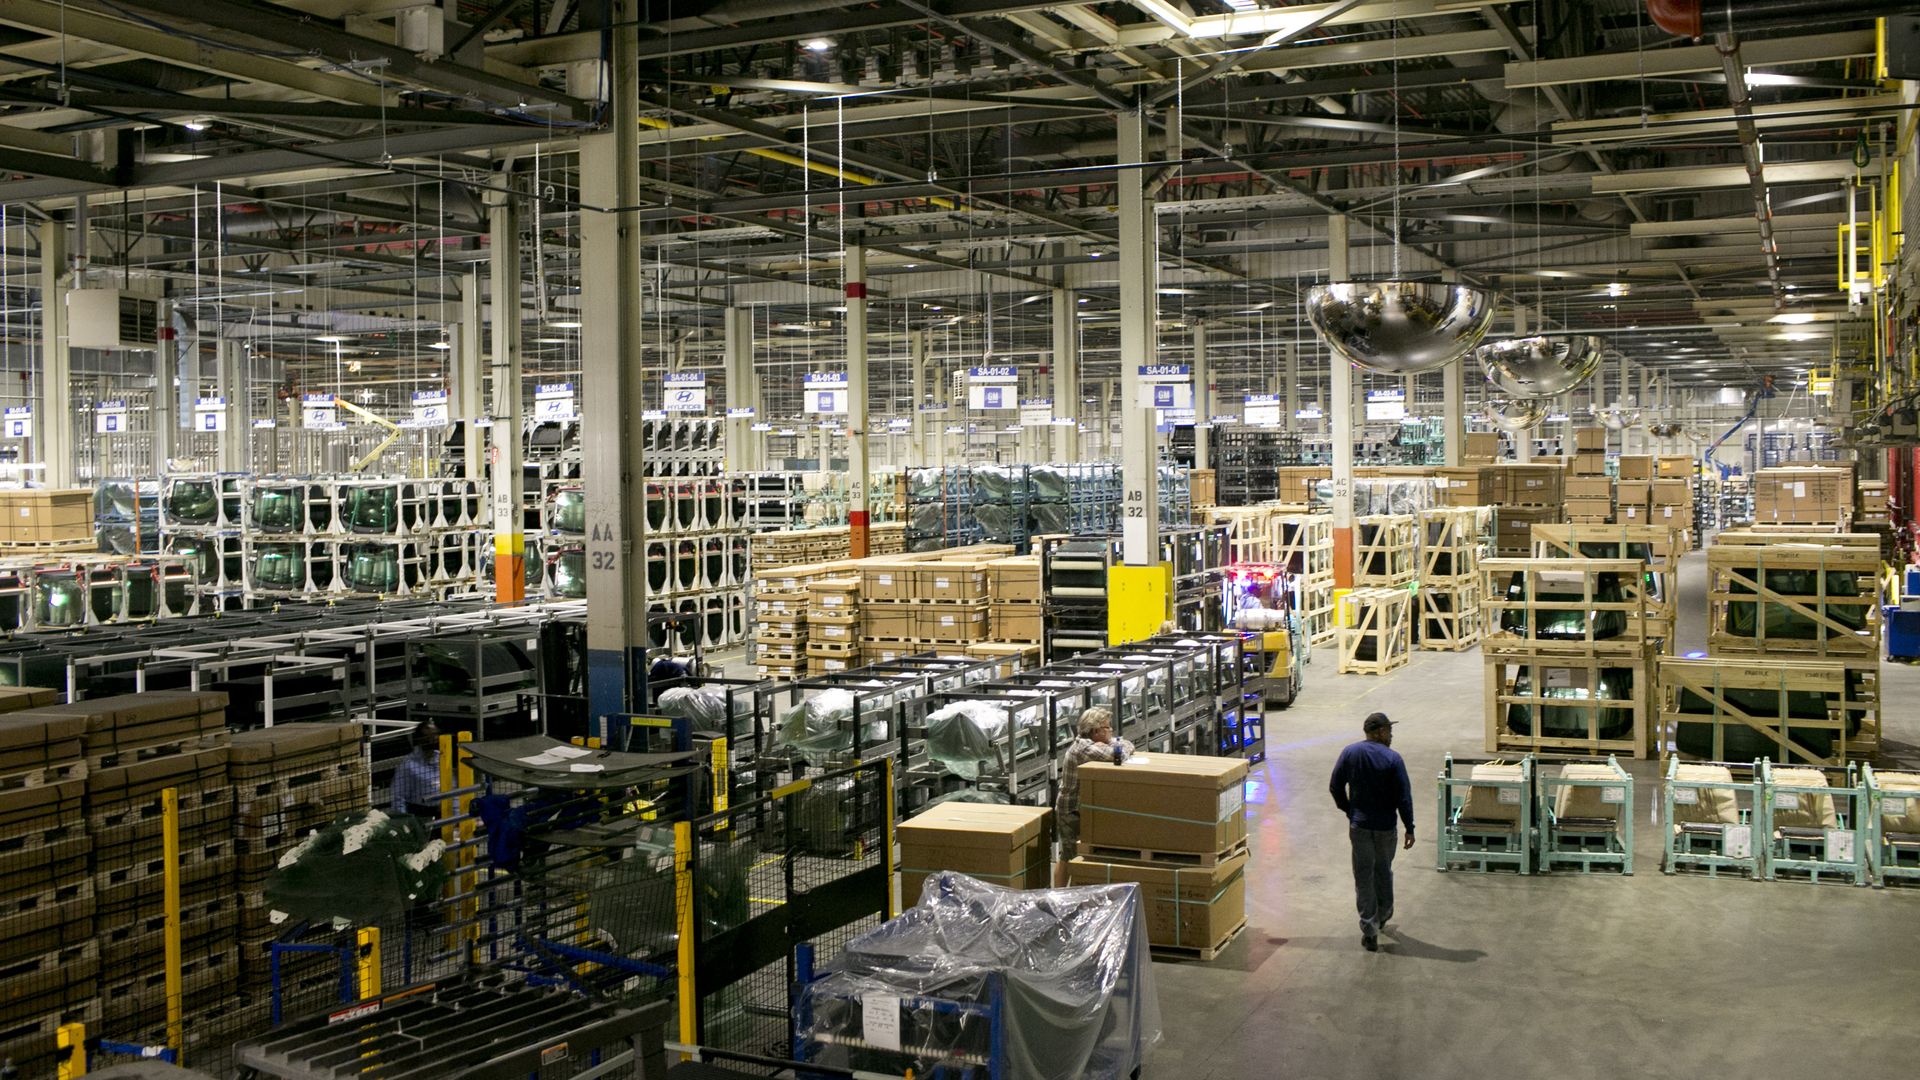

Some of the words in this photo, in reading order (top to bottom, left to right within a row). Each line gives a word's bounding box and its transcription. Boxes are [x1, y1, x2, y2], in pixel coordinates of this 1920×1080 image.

[977, 367, 1009, 376] SA-01-02
[1146, 365, 1180, 375] SA-01-01
[670, 373, 698, 381] SA-01-04
[811, 373, 840, 382] SA-01-03
[987, 391, 998, 401] GM
[1158, 389, 1170, 400] GM
[497, 494, 508, 503] AB
[1127, 490, 1142, 501] AB
[497, 507, 508, 517] 33
[1128, 506, 1143, 517] 32
[592, 523, 614, 542] AA
[592, 551, 615, 570] 32
